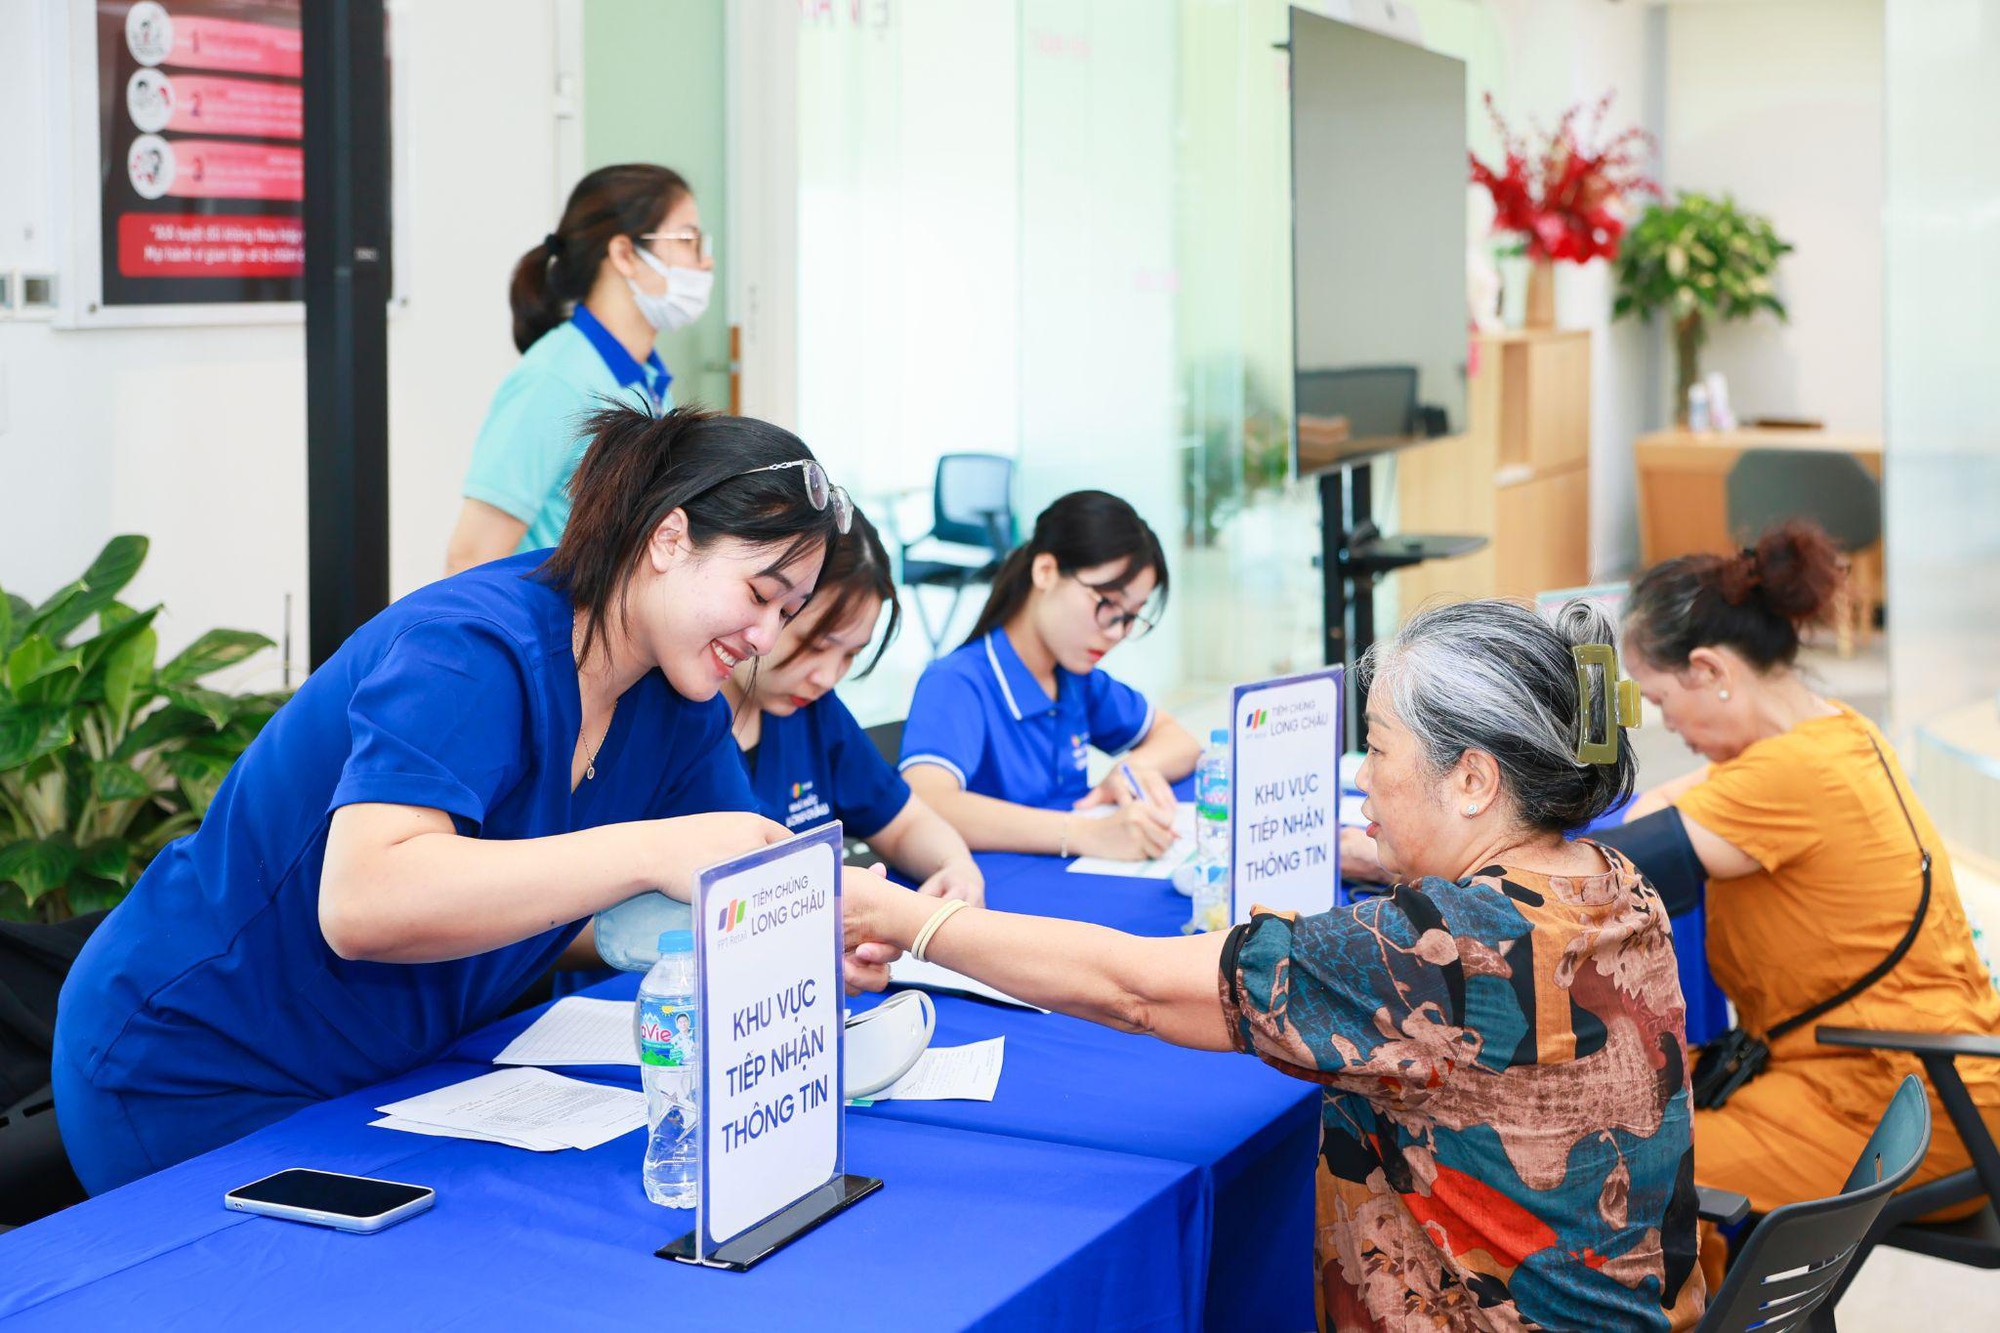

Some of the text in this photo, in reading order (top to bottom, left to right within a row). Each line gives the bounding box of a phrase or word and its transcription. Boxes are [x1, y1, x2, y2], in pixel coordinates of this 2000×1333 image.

[1270, 719, 1299, 737] LONG
[1254, 773, 1319, 806] KHU VỰC
[1282, 808, 1324, 837] NHẬN
[1245, 843, 1327, 883] THÔNG TIN
[751, 889, 825, 937] LONG CHÂU
[752, 886, 773, 909] TIÊM
[733, 978, 817, 1042] KHU VỰC
[640, 1020, 672, 1043] aVie
[725, 1024, 825, 1098] TIẾP NHẬN
[721, 1074, 828, 1154] THÔNG TIN
